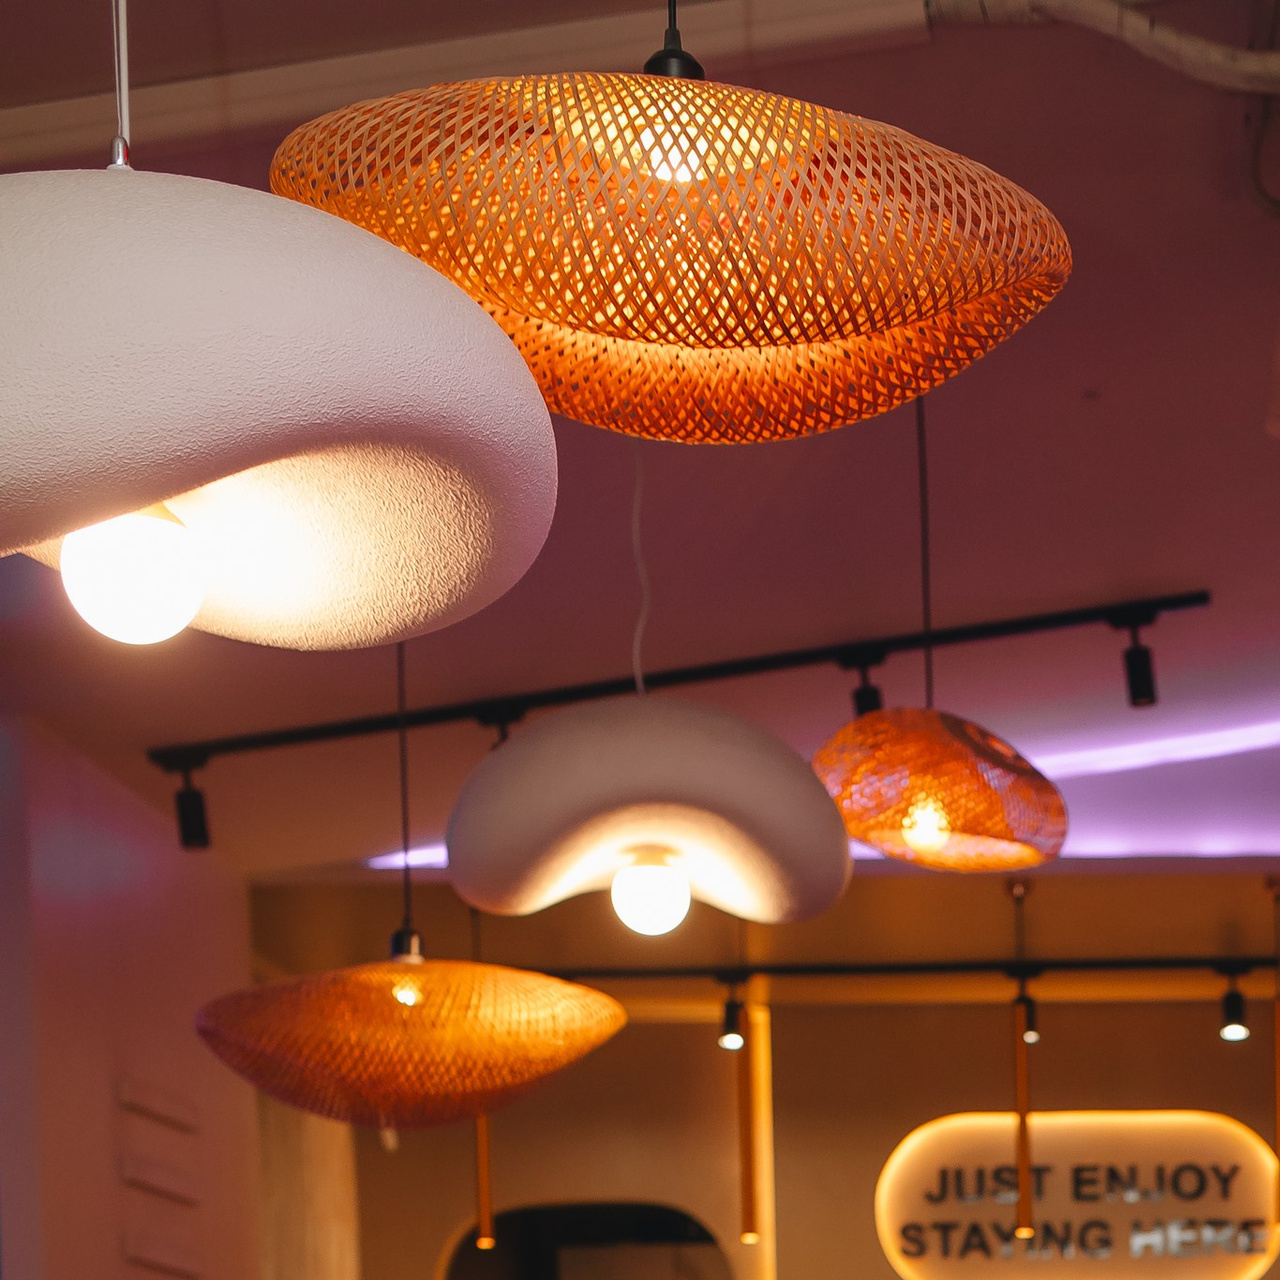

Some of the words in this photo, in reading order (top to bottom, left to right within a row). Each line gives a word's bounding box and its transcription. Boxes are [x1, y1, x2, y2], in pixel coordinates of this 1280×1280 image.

[924, 1163, 1053, 1203] JUST
[1071, 1162, 1240, 1202] ENJOY
[900, 1219, 1112, 1260] STAYING
[1129, 1218, 1269, 1258] HERE
